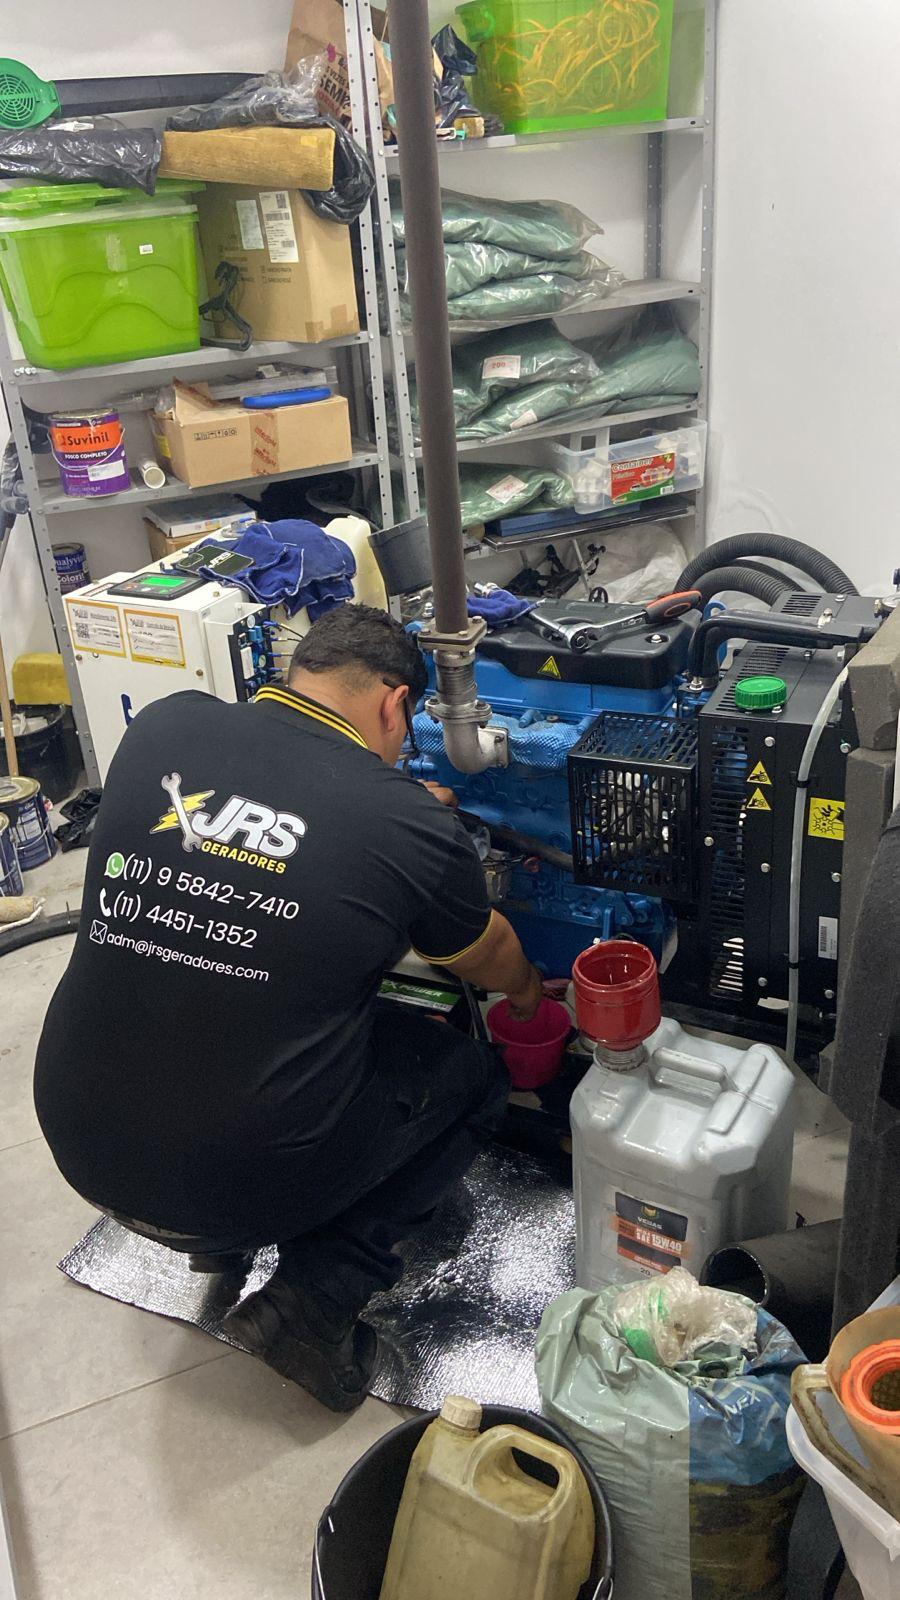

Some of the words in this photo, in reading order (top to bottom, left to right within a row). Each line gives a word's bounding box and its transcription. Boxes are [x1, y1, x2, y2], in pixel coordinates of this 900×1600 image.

[67, 432, 110, 446] Suvinil
[80, 451, 108, 459] COMPLETO
[611, 457, 654, 473] Container
[190, 795, 307, 859] JRS
[201, 840, 287, 874] GERADORES
[123, 853, 153, 885] (11)
[157, 867, 172, 886] 9
[175, 871, 300, 920] 5842-7410
[113, 890, 142, 922] (11)
[146, 905, 258, 949] 4451-1352
[106, 932, 270, 982] adm@jrsgeradores.com
[651, 1233, 682, 1251] 15W40
